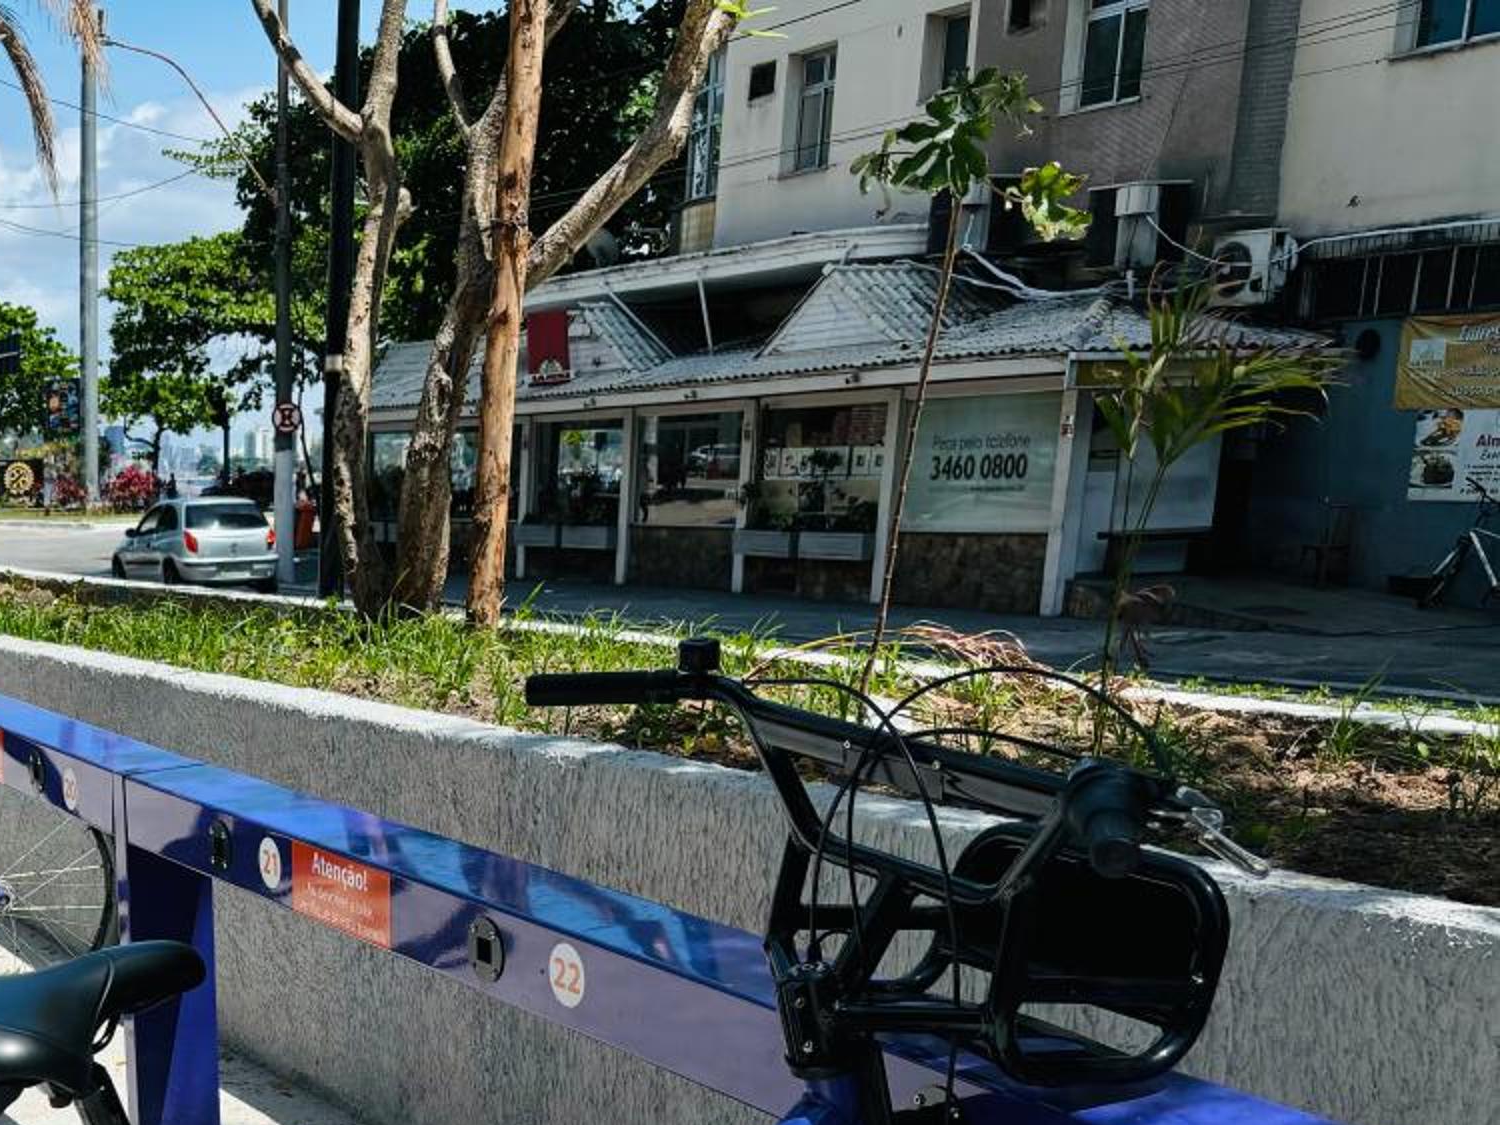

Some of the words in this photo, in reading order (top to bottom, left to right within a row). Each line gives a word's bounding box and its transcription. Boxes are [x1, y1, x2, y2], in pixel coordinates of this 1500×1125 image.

[930, 454, 975, 480] 3460
[981, 453, 1028, 479] 0800
[311, 852, 368, 892] Atenção!
[553, 957, 581, 993] 22
